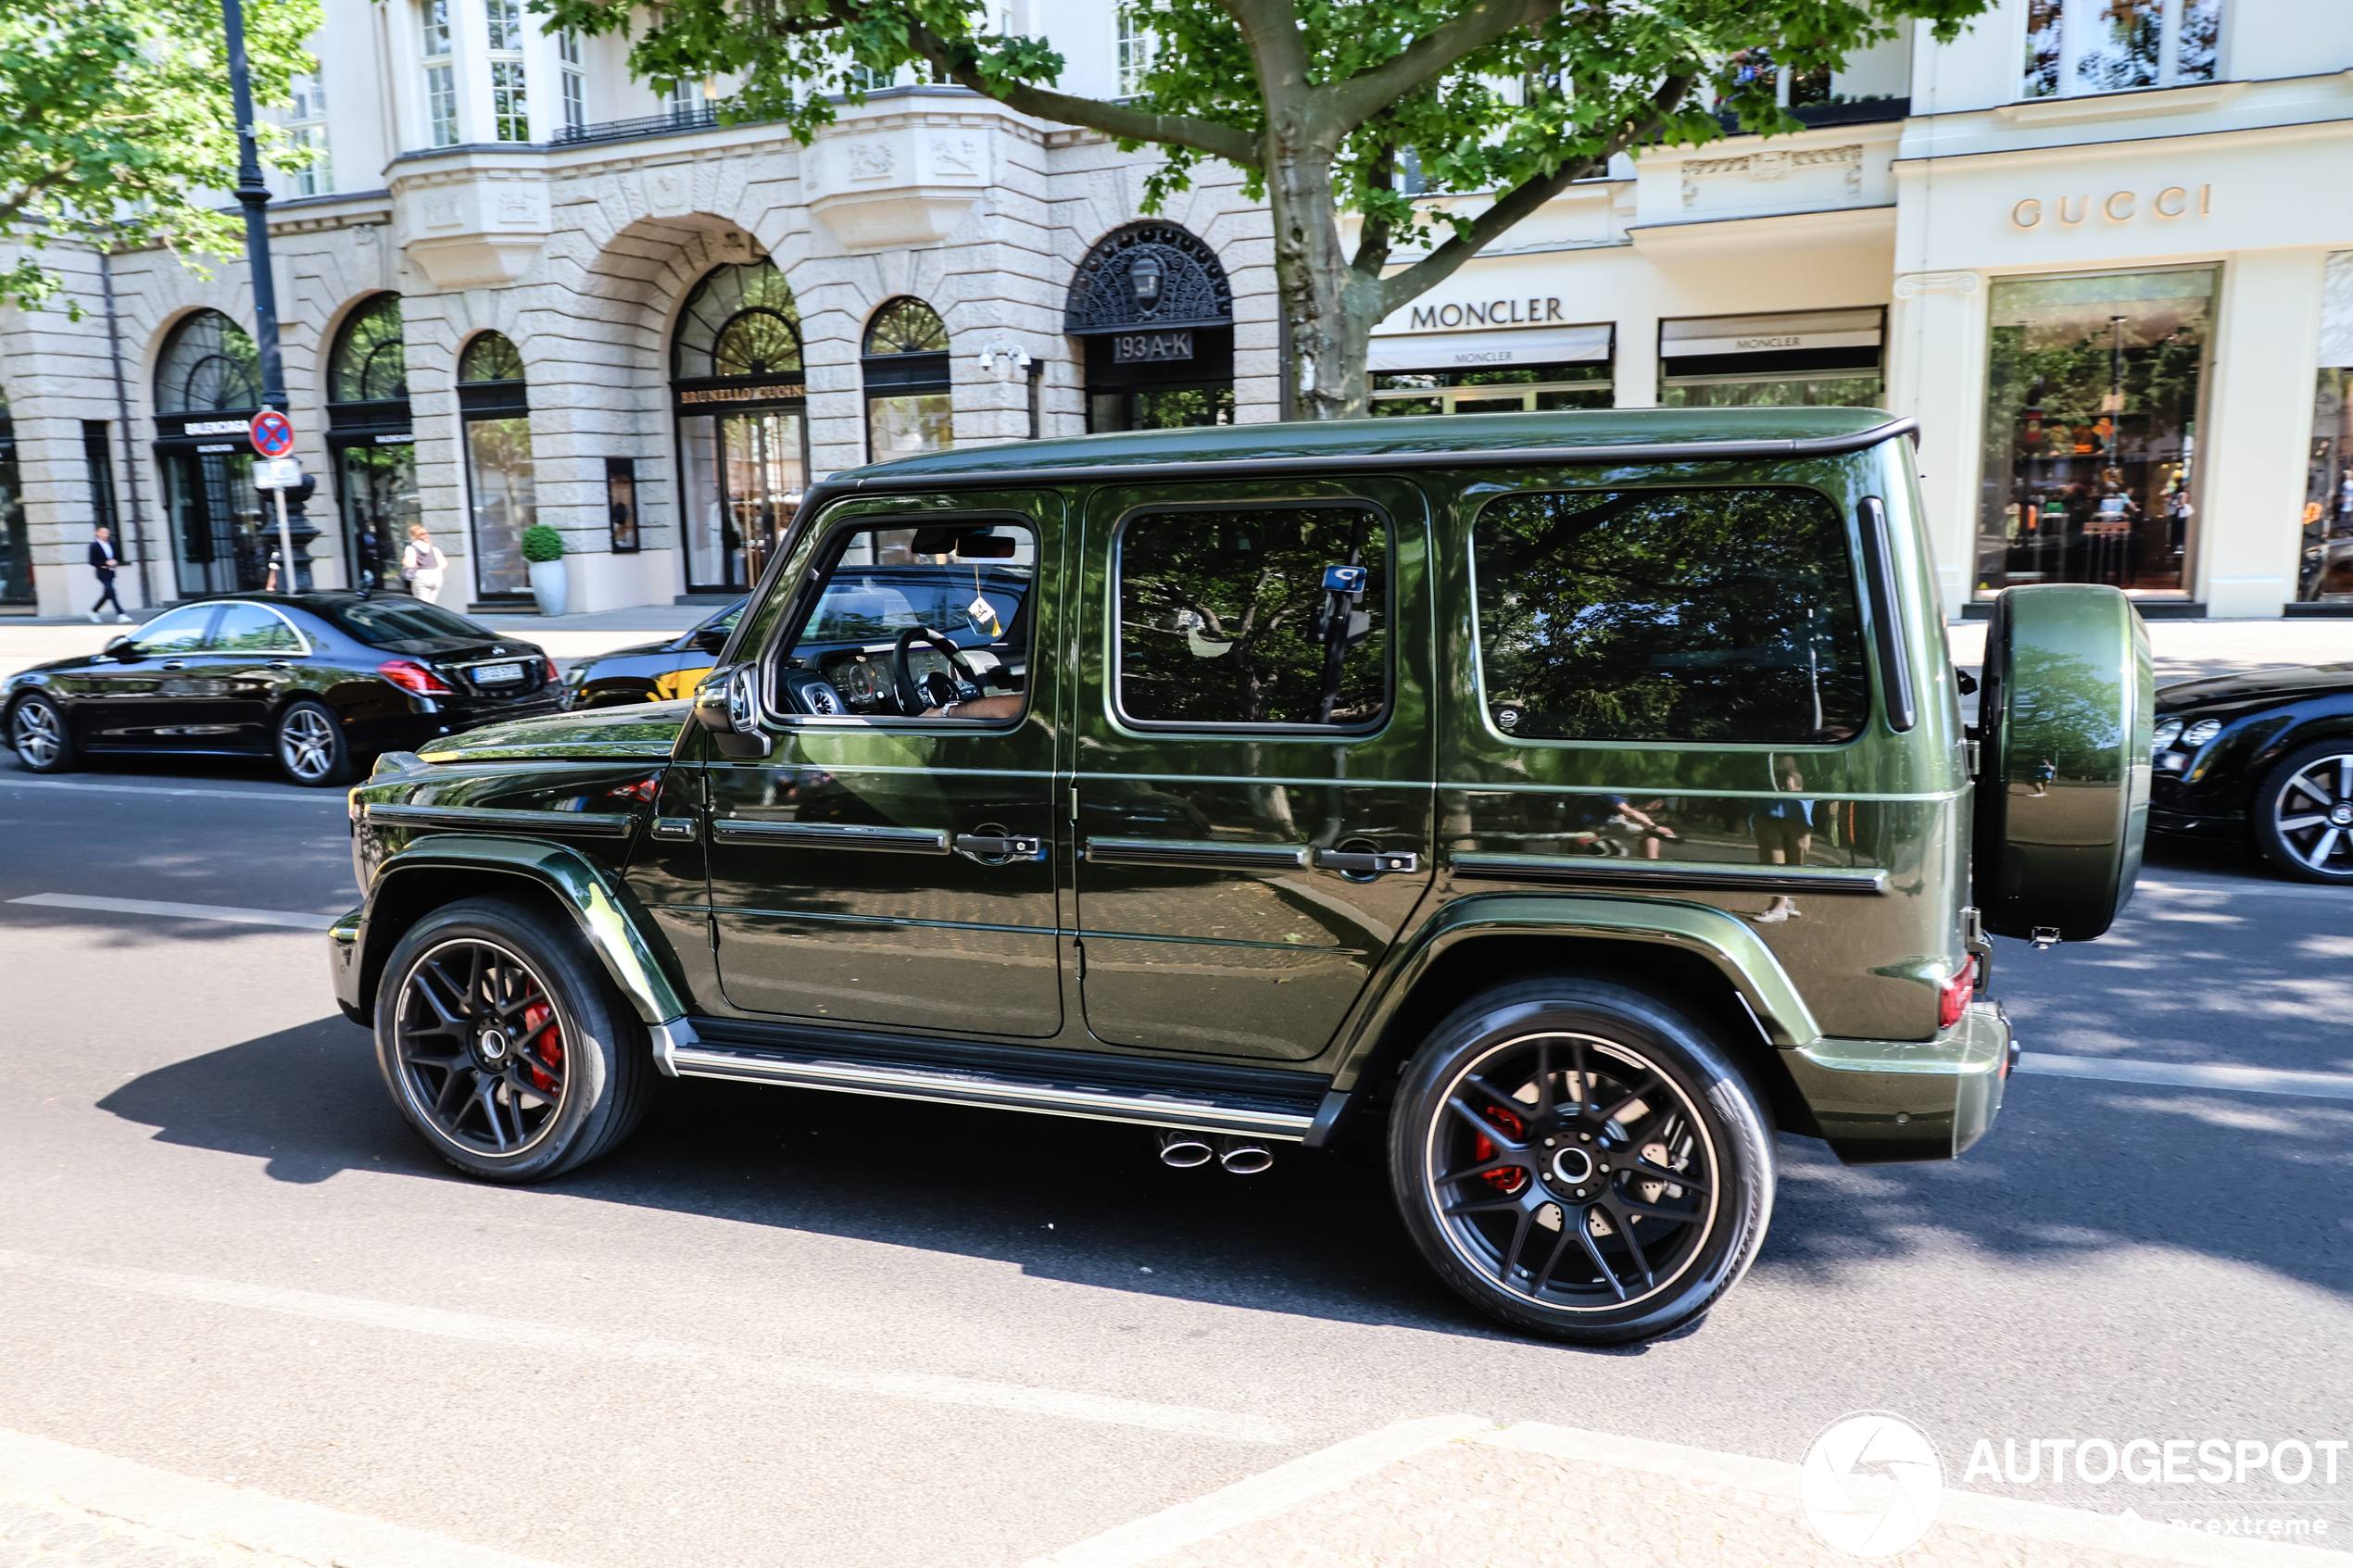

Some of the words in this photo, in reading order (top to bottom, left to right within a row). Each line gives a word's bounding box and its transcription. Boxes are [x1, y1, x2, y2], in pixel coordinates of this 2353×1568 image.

[2011, 183, 2212, 230] GUCCI
[1411, 297, 1566, 330] MONCLER
[1114, 335, 1147, 358] 193
[1150, 333, 1190, 357] A-K
[1735, 336, 1801, 350] MONCLER
[1454, 351, 1514, 363] MONCLER
[681, 387, 753, 404] BRUNELLO
